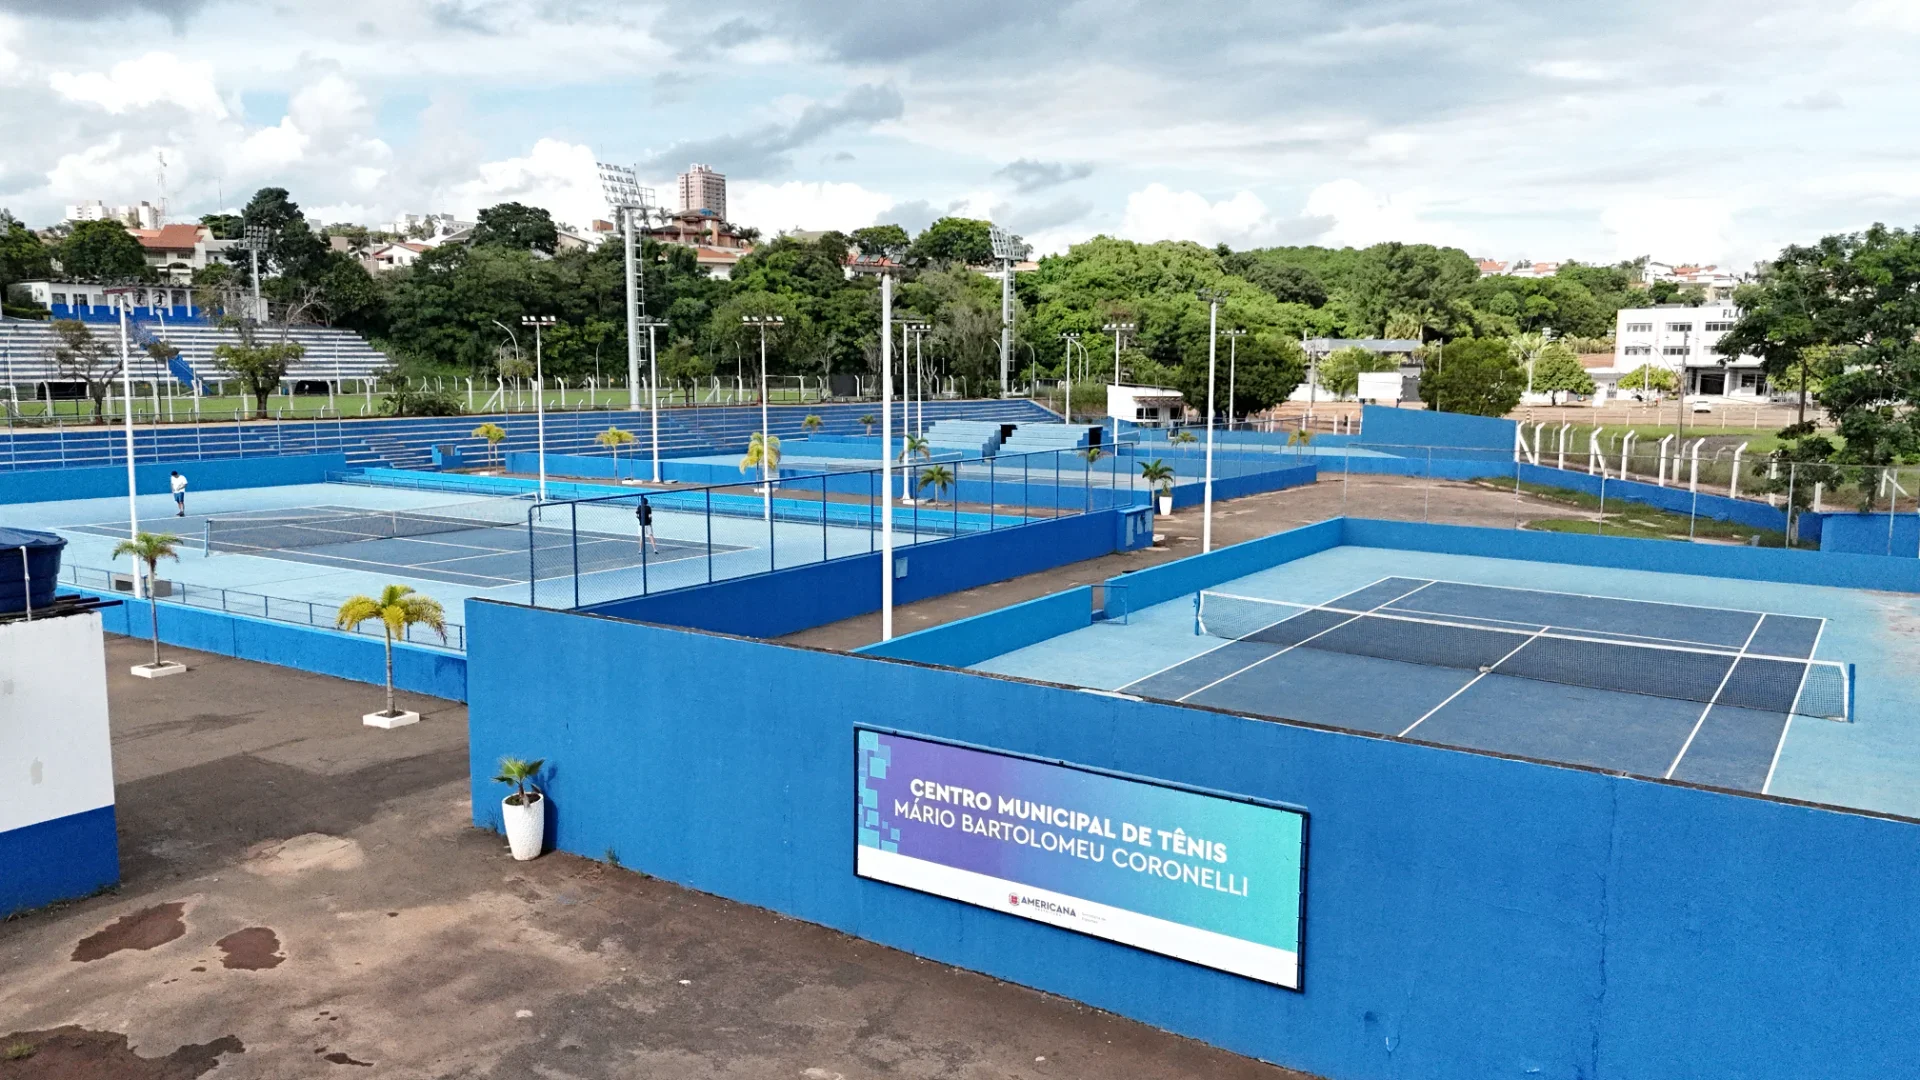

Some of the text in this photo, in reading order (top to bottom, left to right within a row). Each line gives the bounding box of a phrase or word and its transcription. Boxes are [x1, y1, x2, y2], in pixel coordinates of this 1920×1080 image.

[894, 798, 1248, 897] MÁRIO BARTOLOMEU CORONELLI
[910, 778, 1228, 864] CENTRO MUNICIPAL DE TÊNIS
[1021, 896, 1077, 917] AMERICANA
